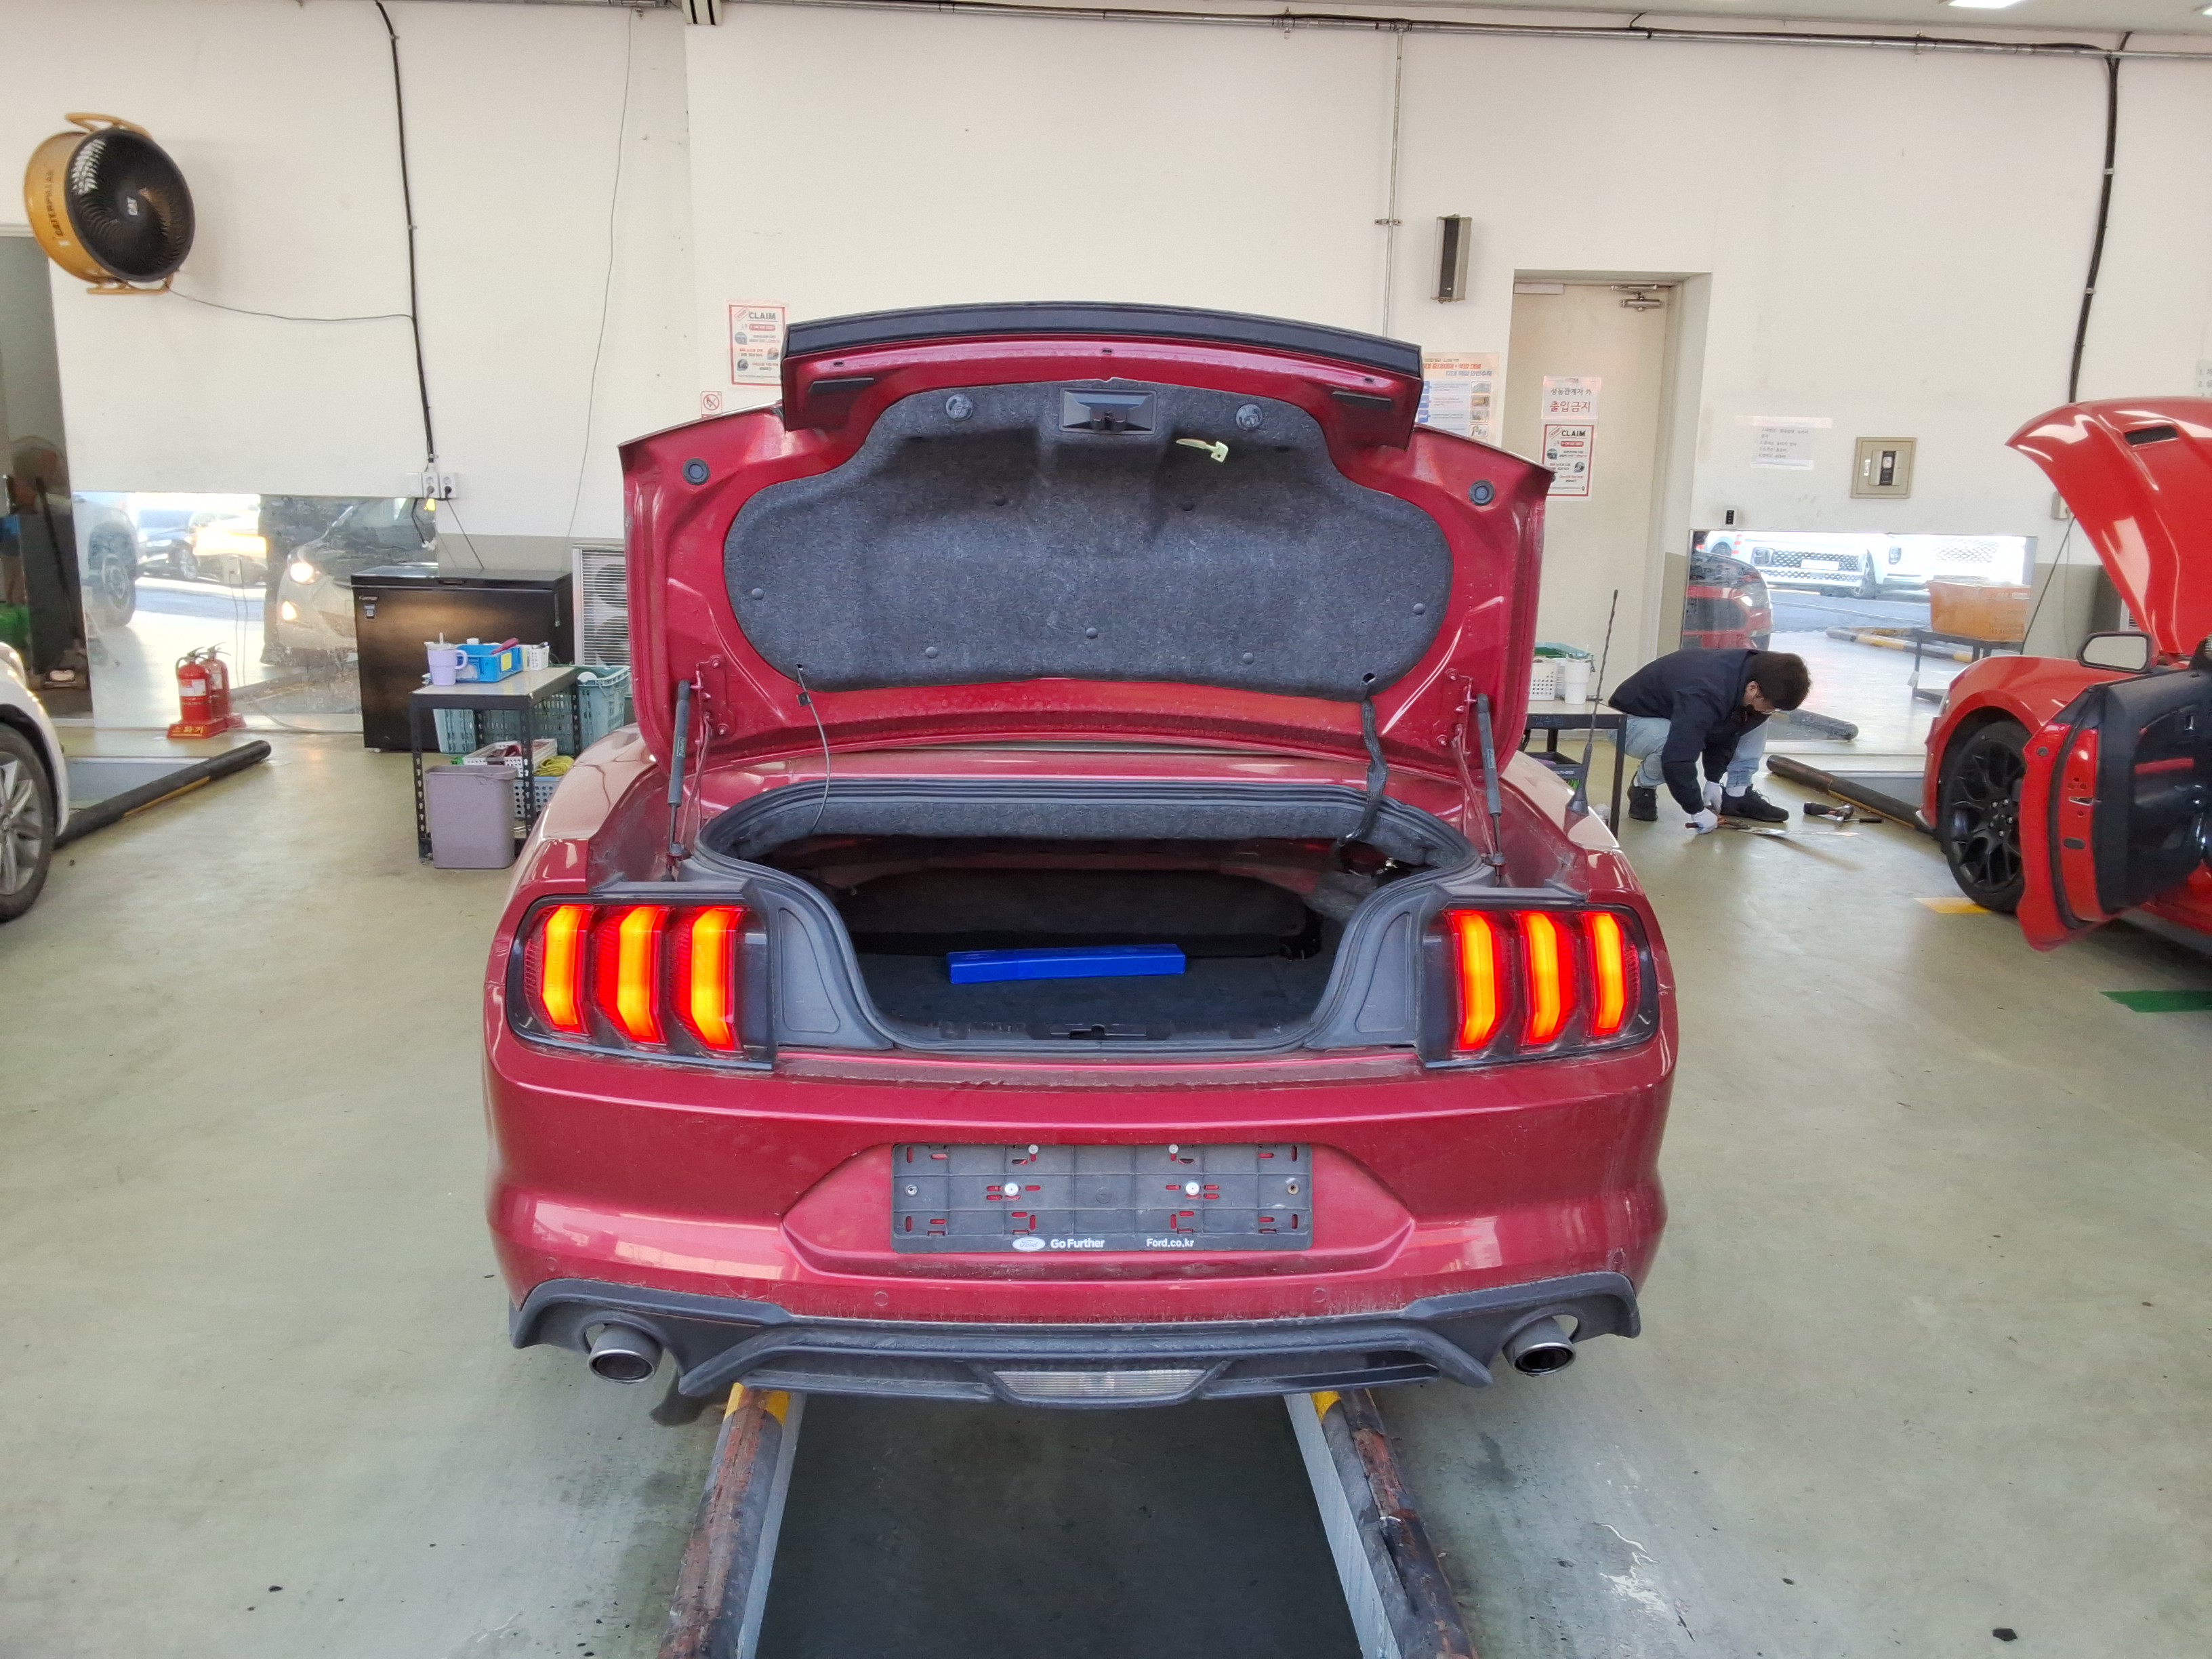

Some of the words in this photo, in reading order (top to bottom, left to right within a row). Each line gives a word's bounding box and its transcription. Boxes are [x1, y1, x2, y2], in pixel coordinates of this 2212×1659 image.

[1549, 401, 1591, 413] 출입금지
[1050, 1239, 1066, 1248] Go
[1067, 1238, 1105, 1248] Further
[1146, 1238, 1195, 1248] Ford.co.kr
